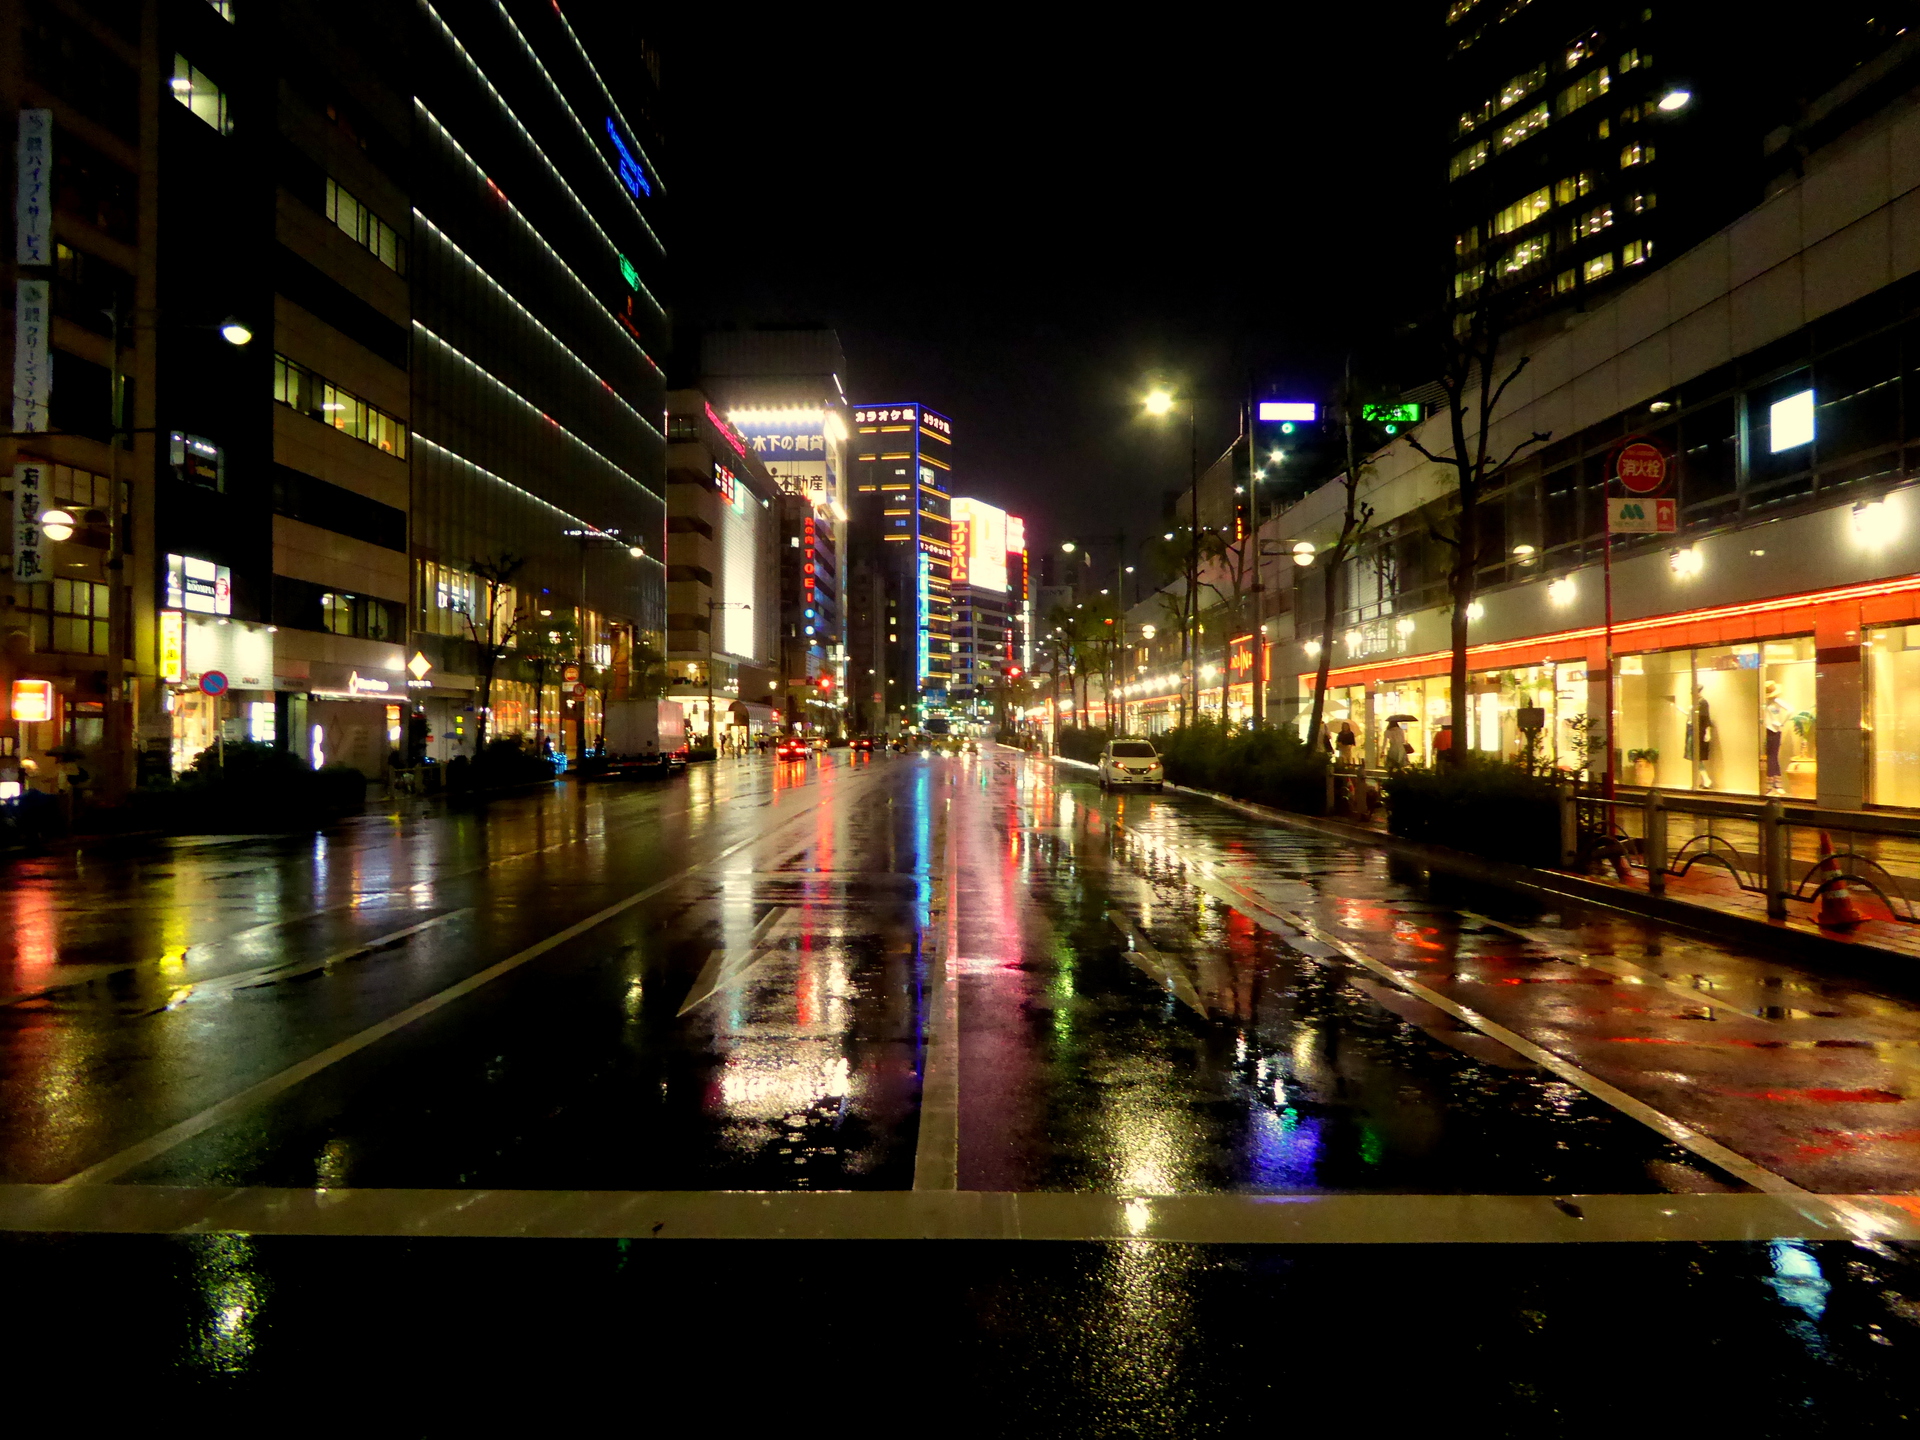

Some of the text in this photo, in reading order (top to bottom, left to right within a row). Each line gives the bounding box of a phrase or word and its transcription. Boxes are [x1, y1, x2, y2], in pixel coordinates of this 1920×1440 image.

[753, 434, 824, 452] 木下の賃貸
[1621, 458, 1662, 478] 消火栓
[772, 474, 824, 491] 不動産
[951, 521, 969, 580] プリマハム
